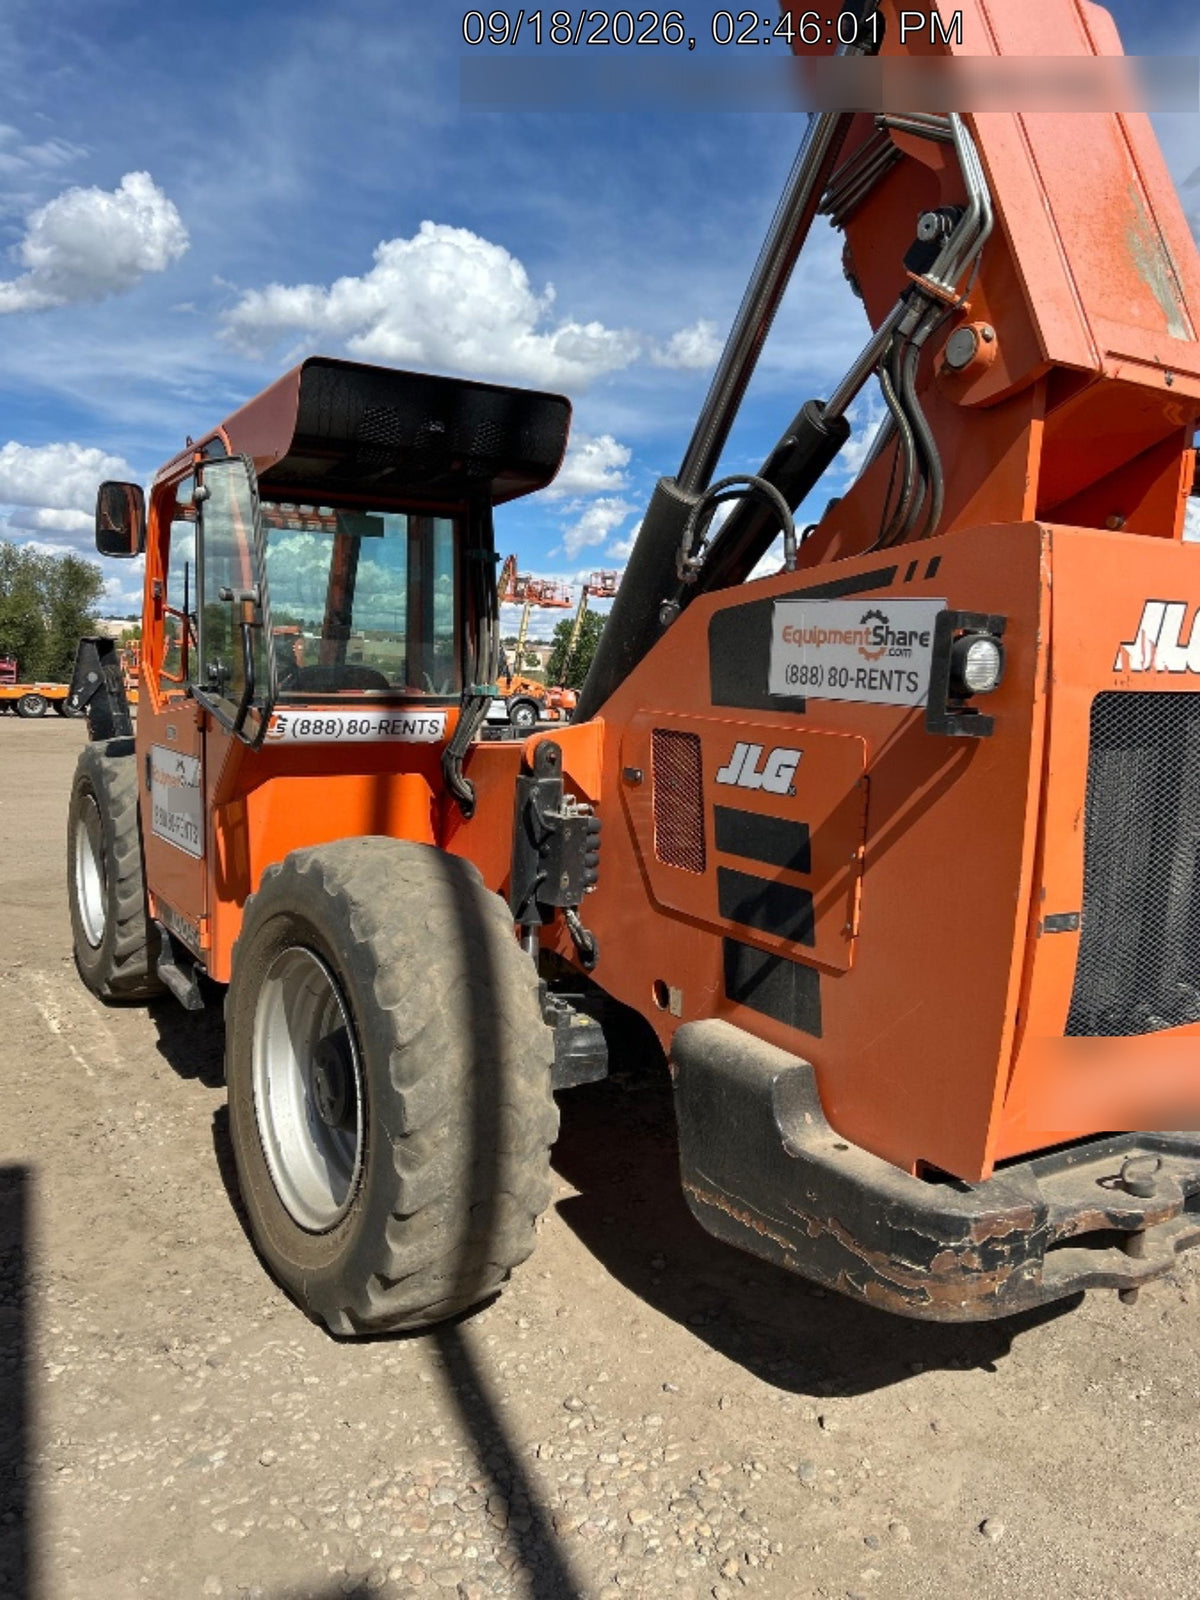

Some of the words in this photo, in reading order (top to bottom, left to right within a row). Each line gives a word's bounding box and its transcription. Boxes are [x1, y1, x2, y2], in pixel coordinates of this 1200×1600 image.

[781, 624, 931, 648] EquipmentShare
[785, 664, 824, 689] (888)
[828, 666, 919, 693] 80-RENTS
[292, 717, 344, 738] (888)
[346, 719, 440, 735] 80-RENTS
[714, 741, 803, 795] JLG
